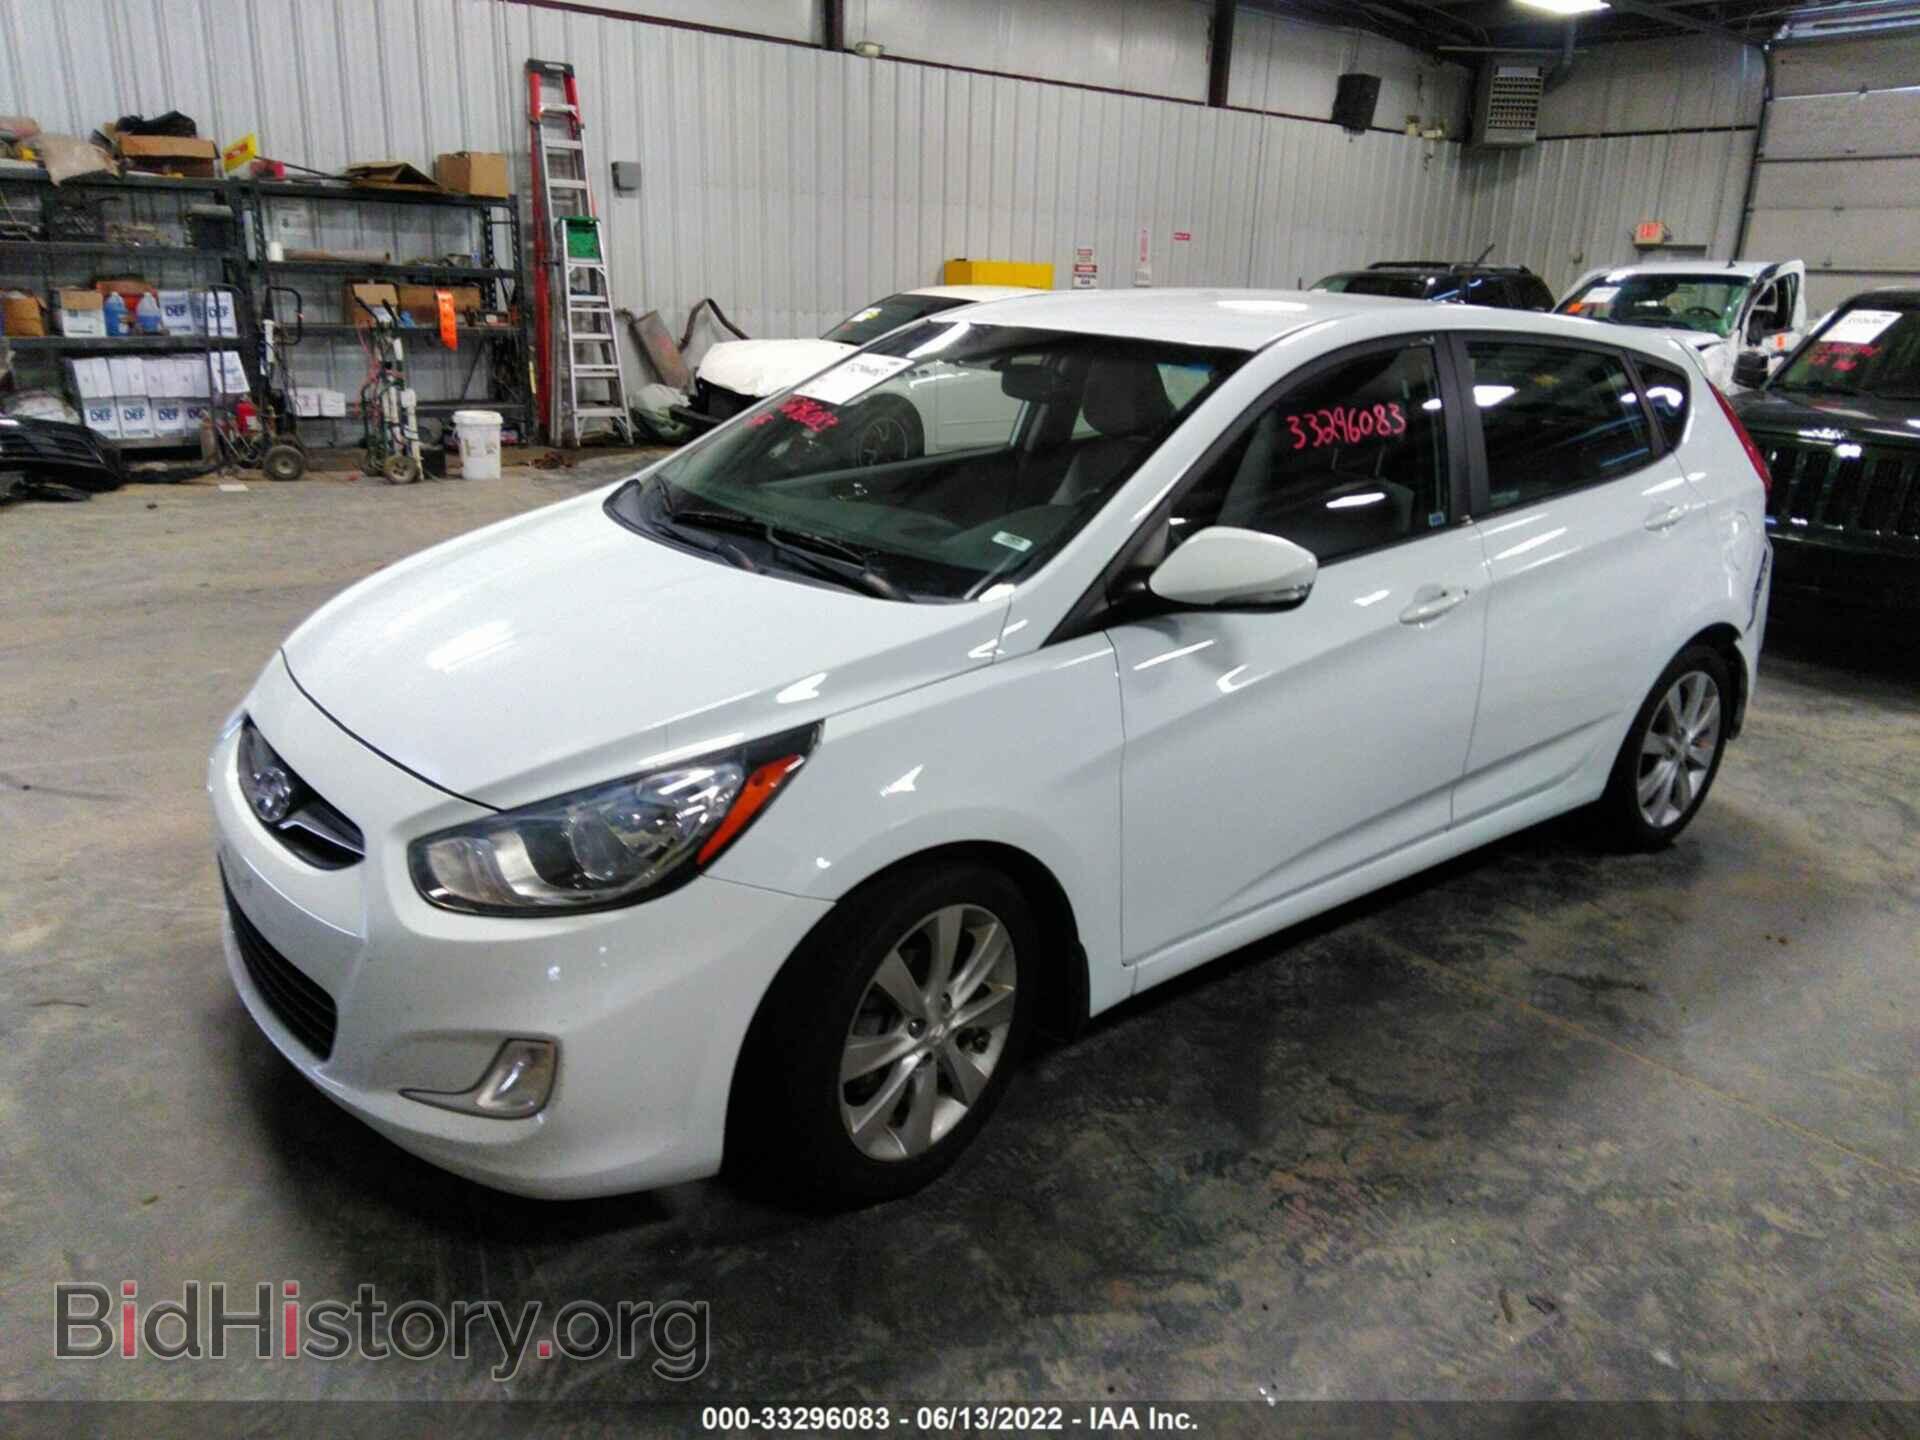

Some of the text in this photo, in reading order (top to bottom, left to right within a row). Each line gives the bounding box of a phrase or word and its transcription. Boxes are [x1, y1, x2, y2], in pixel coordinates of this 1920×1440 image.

[165, 304, 187, 318] DEF
[89, 408, 112, 422] DEF
[124, 407, 146, 421] DEF
[158, 407, 178, 421] DEF
[1286, 403, 1407, 449] 33296083
